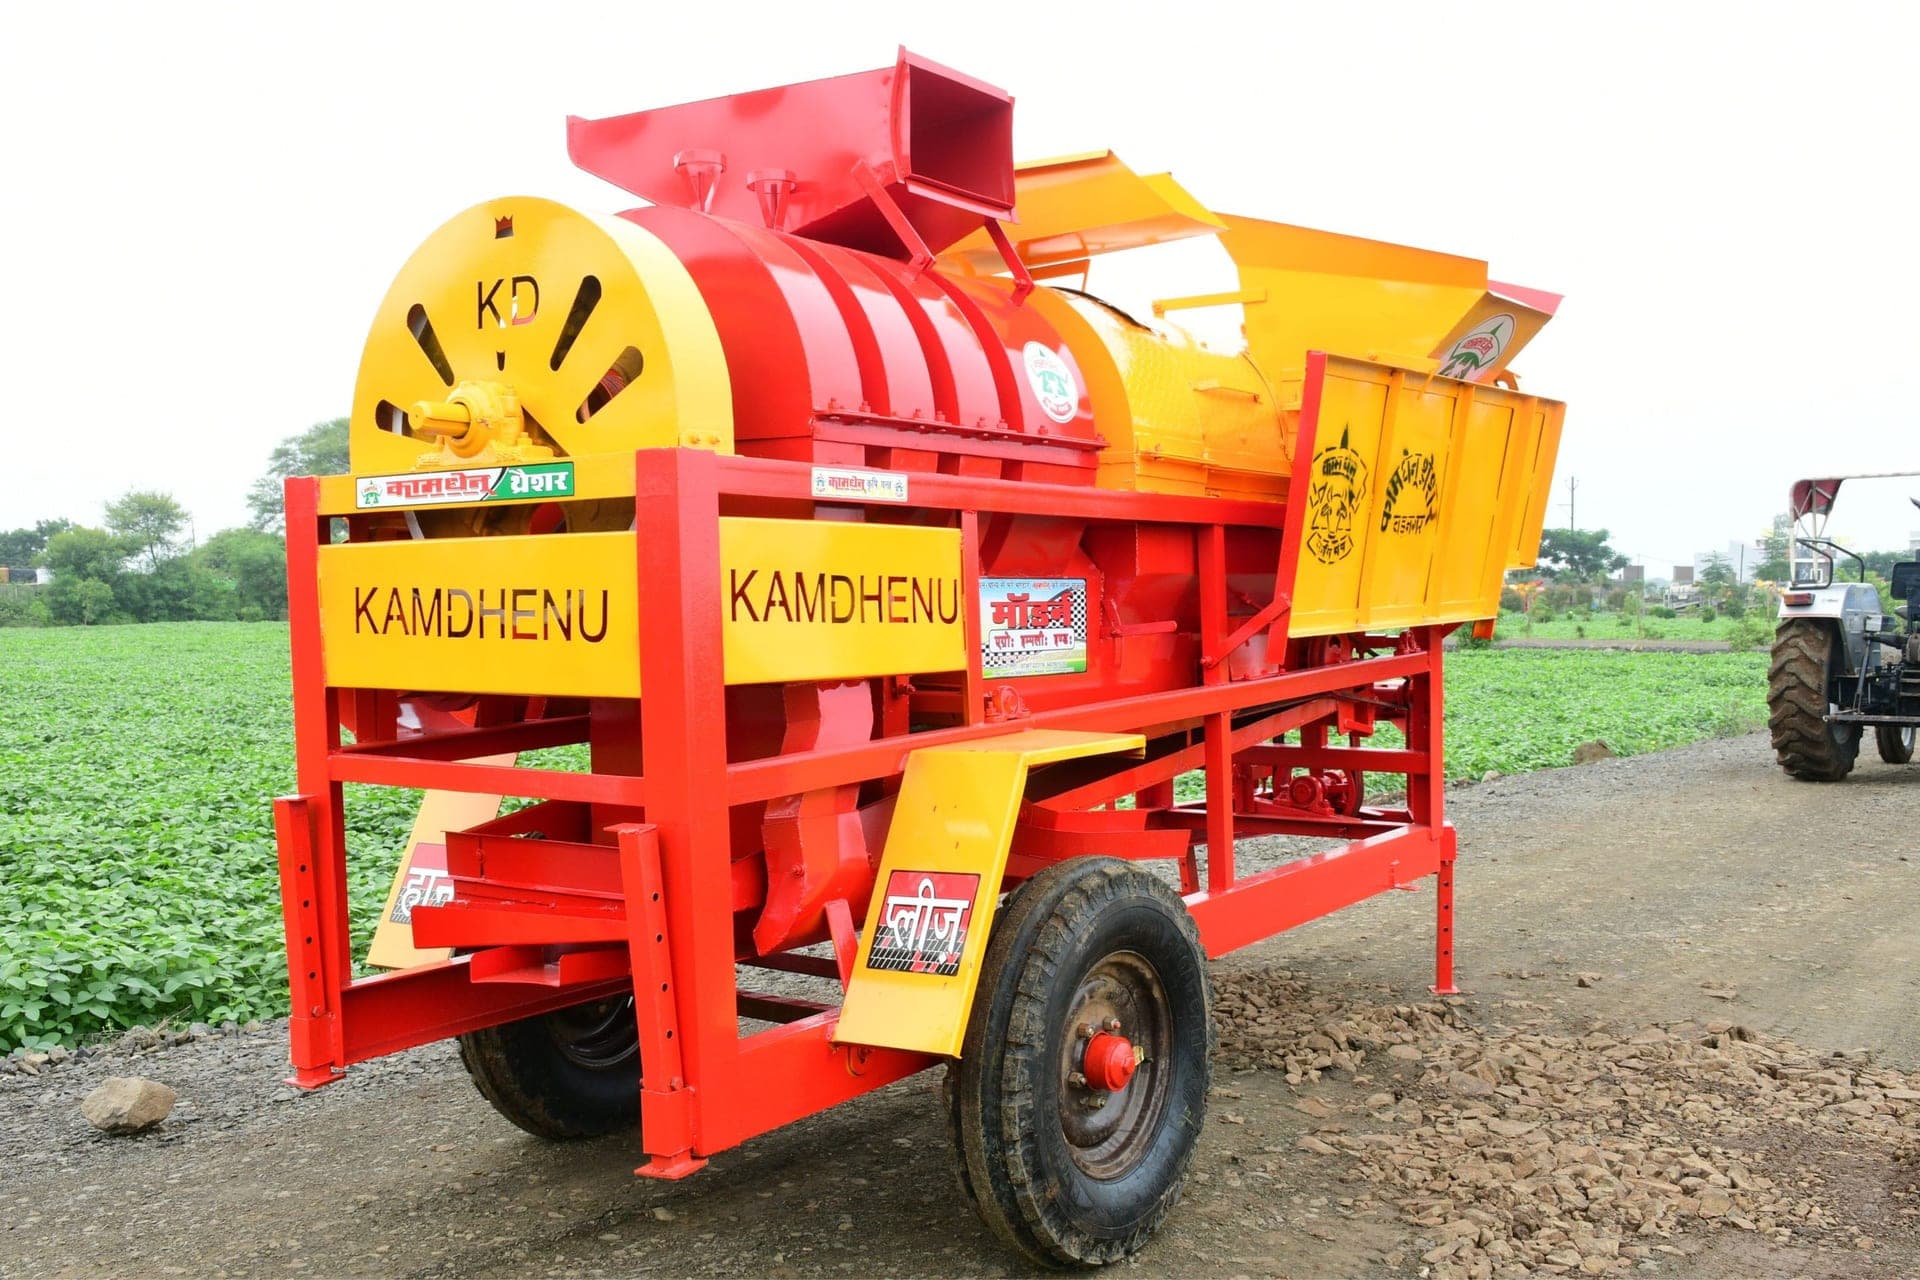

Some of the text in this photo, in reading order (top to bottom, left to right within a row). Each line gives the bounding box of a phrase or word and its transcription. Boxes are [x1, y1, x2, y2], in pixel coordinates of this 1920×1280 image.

[478, 275, 540, 330] KD
[354, 586, 609, 643] KAMDHENU
[730, 568, 958, 625] KAMDHENU
[990, 591, 1074, 629] मॉडर्न
